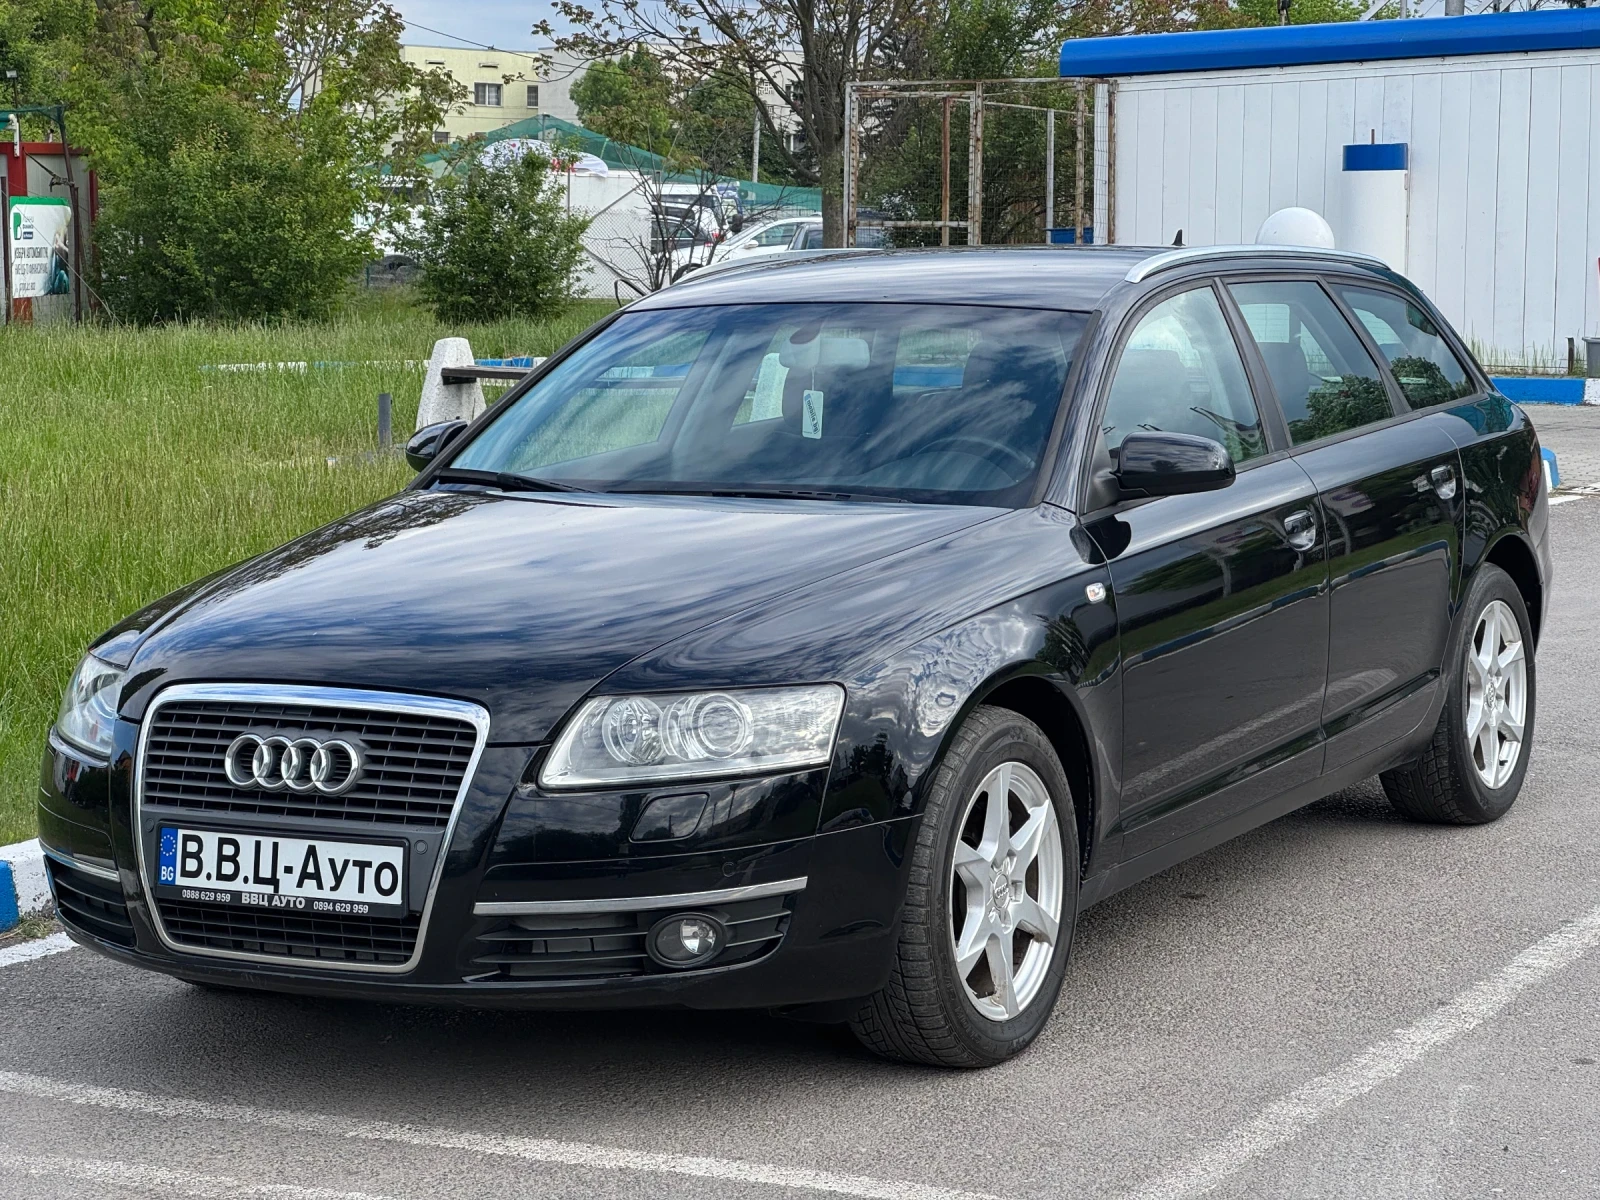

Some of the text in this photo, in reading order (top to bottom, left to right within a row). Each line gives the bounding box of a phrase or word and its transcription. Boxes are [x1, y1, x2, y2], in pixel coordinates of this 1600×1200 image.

[160, 865, 174, 882] BG
[181, 889, 369, 914] 0888 629 959 ВВЦ АУТО 0894 629 959
